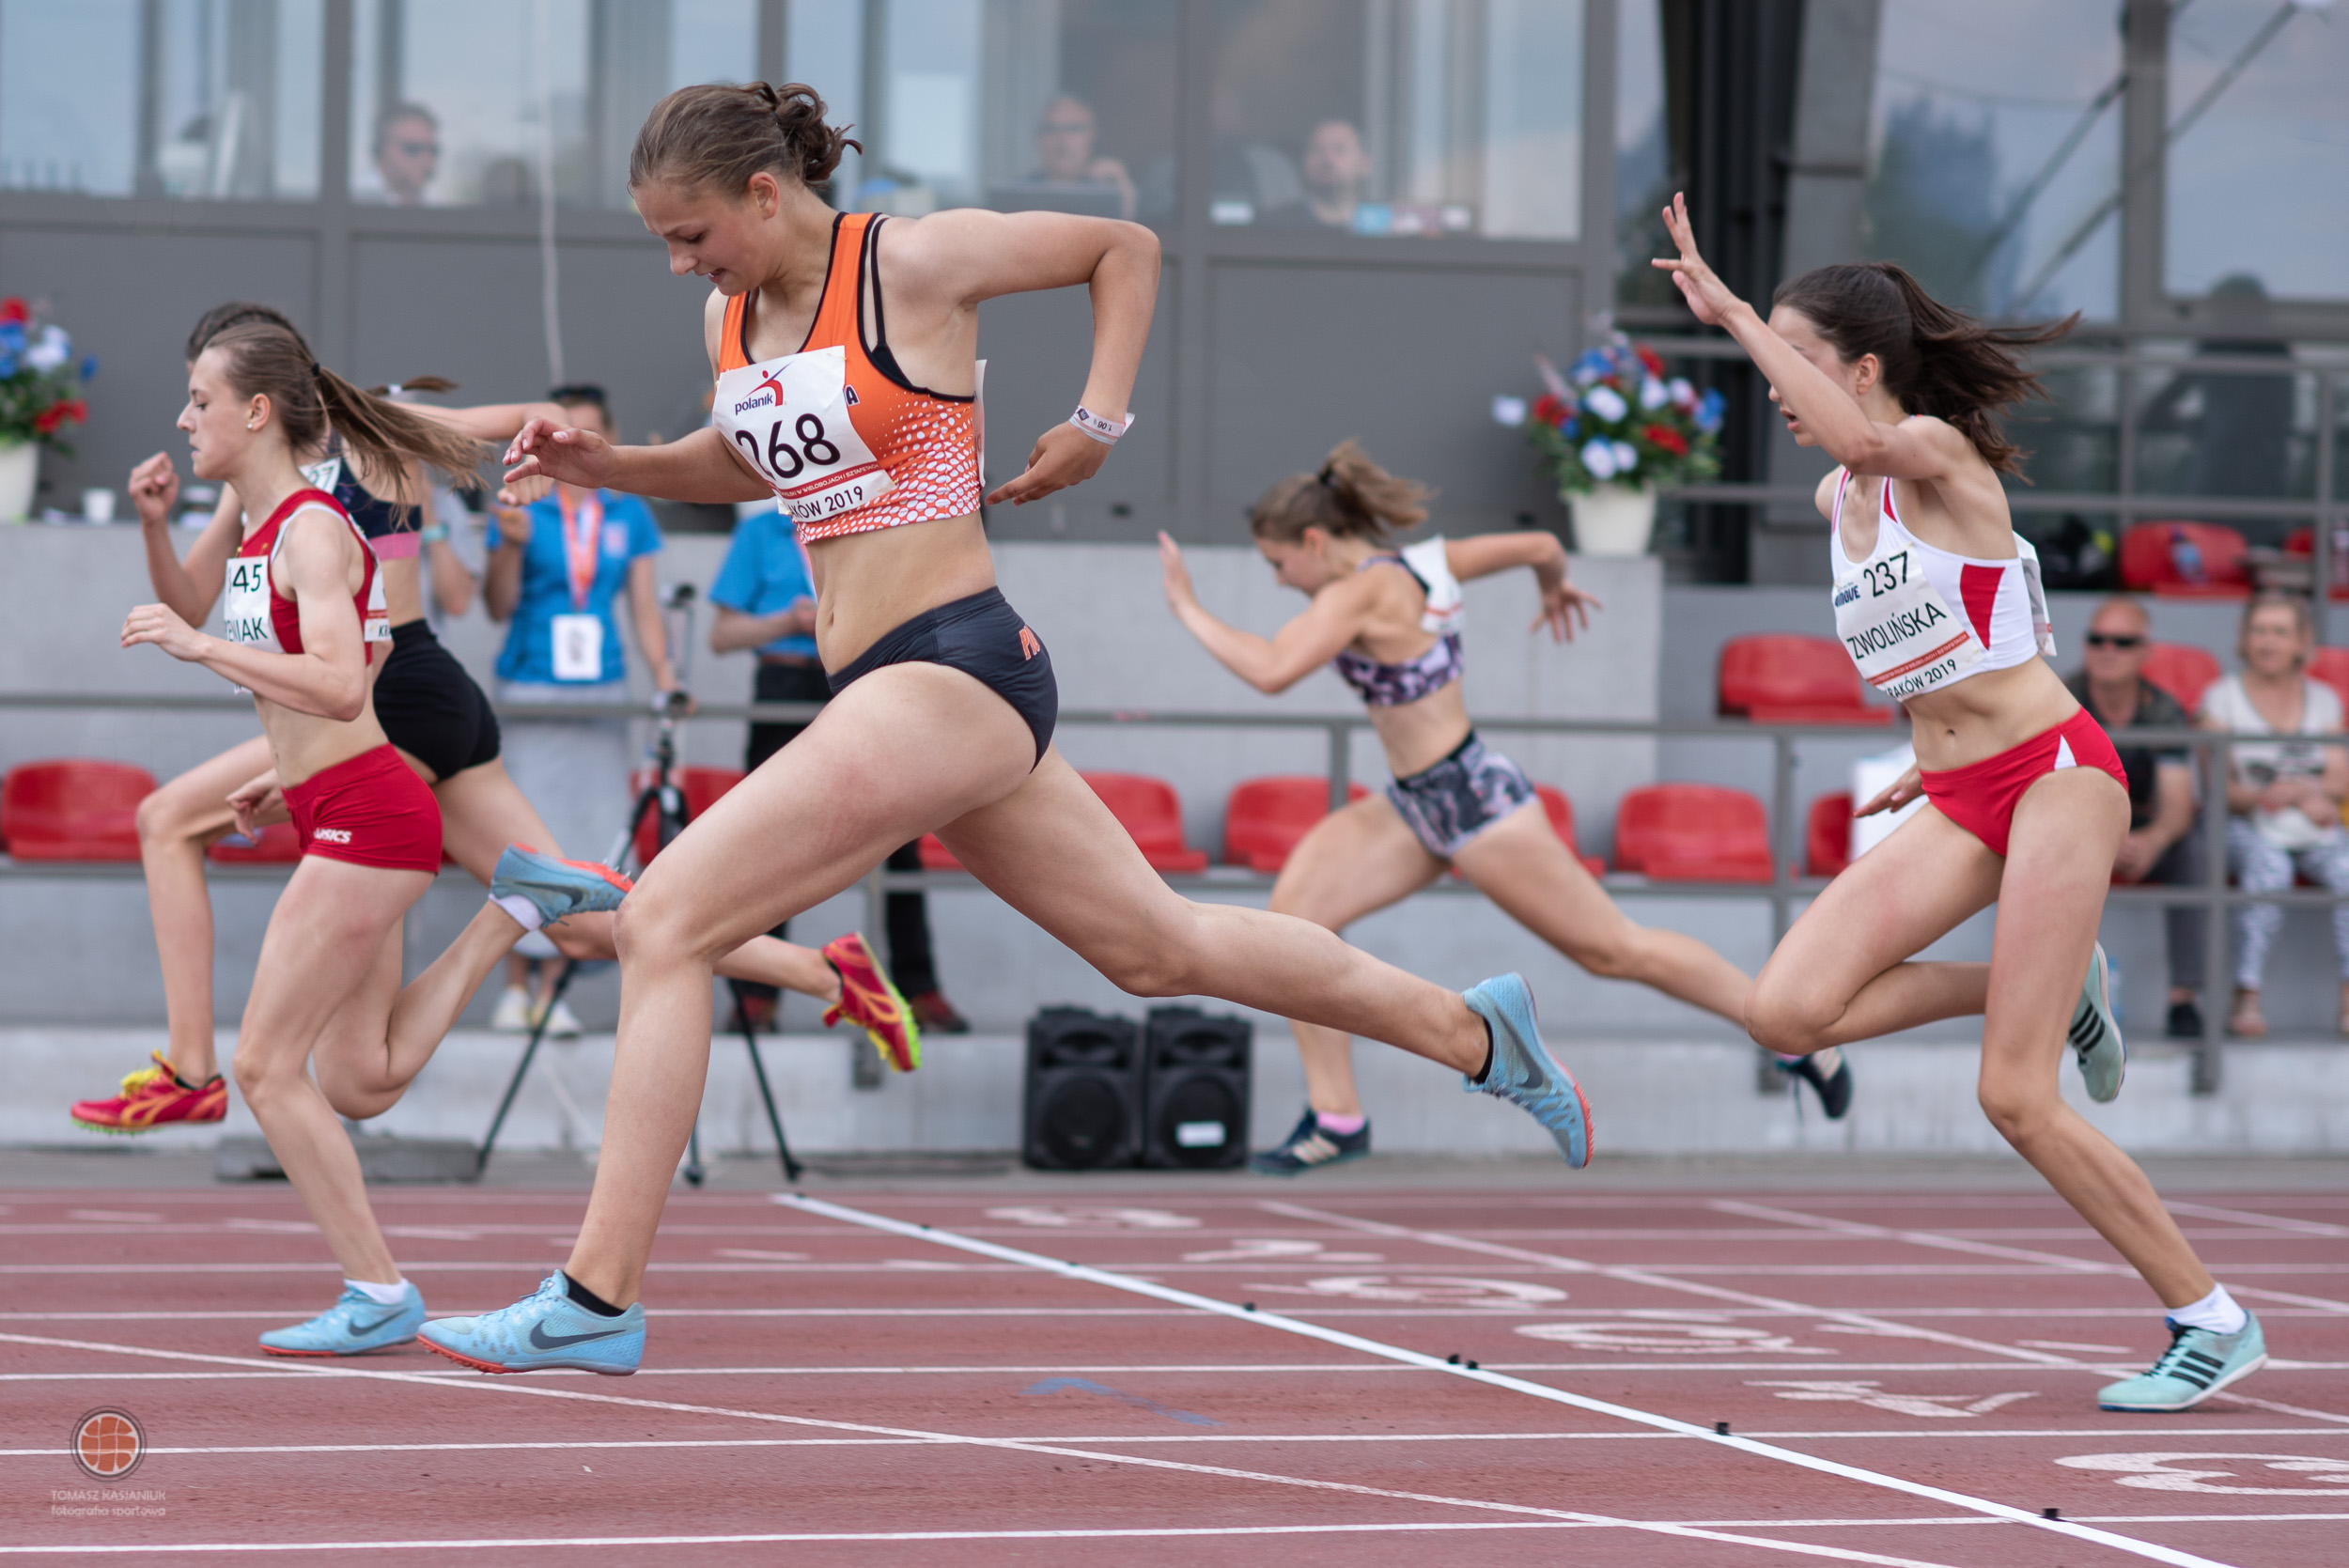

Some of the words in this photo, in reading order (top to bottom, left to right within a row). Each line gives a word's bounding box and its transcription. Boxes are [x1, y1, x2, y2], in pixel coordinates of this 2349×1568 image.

[735, 393, 772, 415] polanik
[735, 413, 841, 479] 268
[825, 486, 863, 512] 2019
[1863, 551, 1907, 598] 237
[1846, 602, 1948, 660] ZWOLIŃSKA
[1924, 659, 1957, 685] 2019
